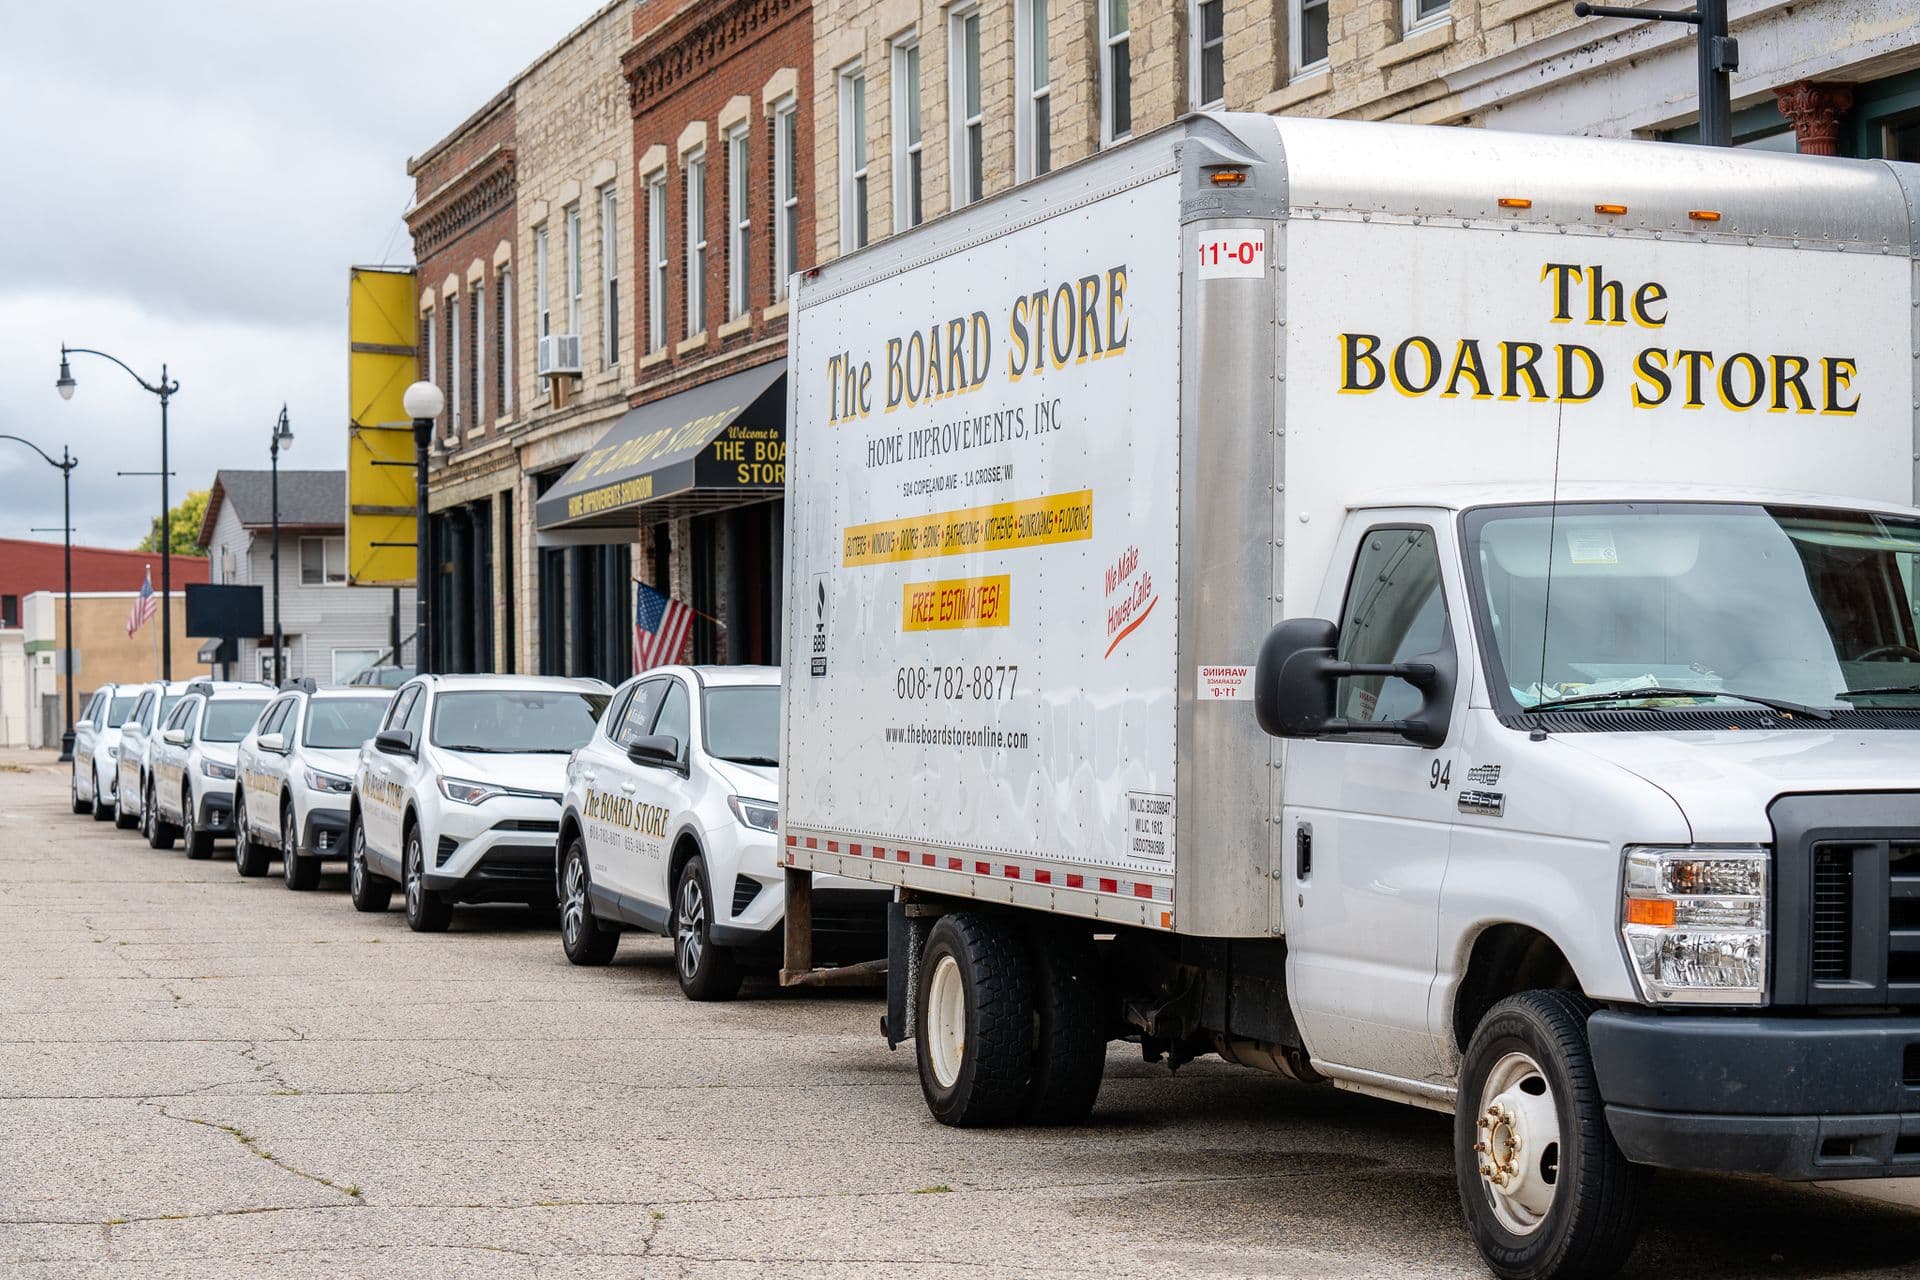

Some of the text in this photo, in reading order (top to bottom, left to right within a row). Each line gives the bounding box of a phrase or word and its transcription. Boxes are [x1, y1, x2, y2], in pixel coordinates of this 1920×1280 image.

[1199, 242, 1263, 266] 11'-0"
[1540, 262, 1669, 328] The
[827, 263, 1130, 427] The BOARD STORE
[1337, 332, 1862, 417] BOARD STORE
[728, 426, 779, 439] Welcome to
[868, 398, 1062, 468] HOME IMPROVEMENTS, INC
[713, 441, 745, 461] THE
[737, 463, 785, 484] STOR
[914, 477, 944, 496] COPELAND
[945, 474, 958, 490] AVE
[1004, 464, 1014, 480] WI
[1058, 504, 1090, 534] FLOORING
[1105, 545, 1139, 598] We Make
[910, 583, 1000, 623] FREE ESTIMATES!
[1107, 571, 1151, 637] House Calls
[897, 665, 1018, 701] 608-782-8877
[885, 724, 1029, 750] www.theboardstoreonline.com
[1429, 758, 1451, 791] 94
[583, 788, 670, 839] The BOARD STORE
